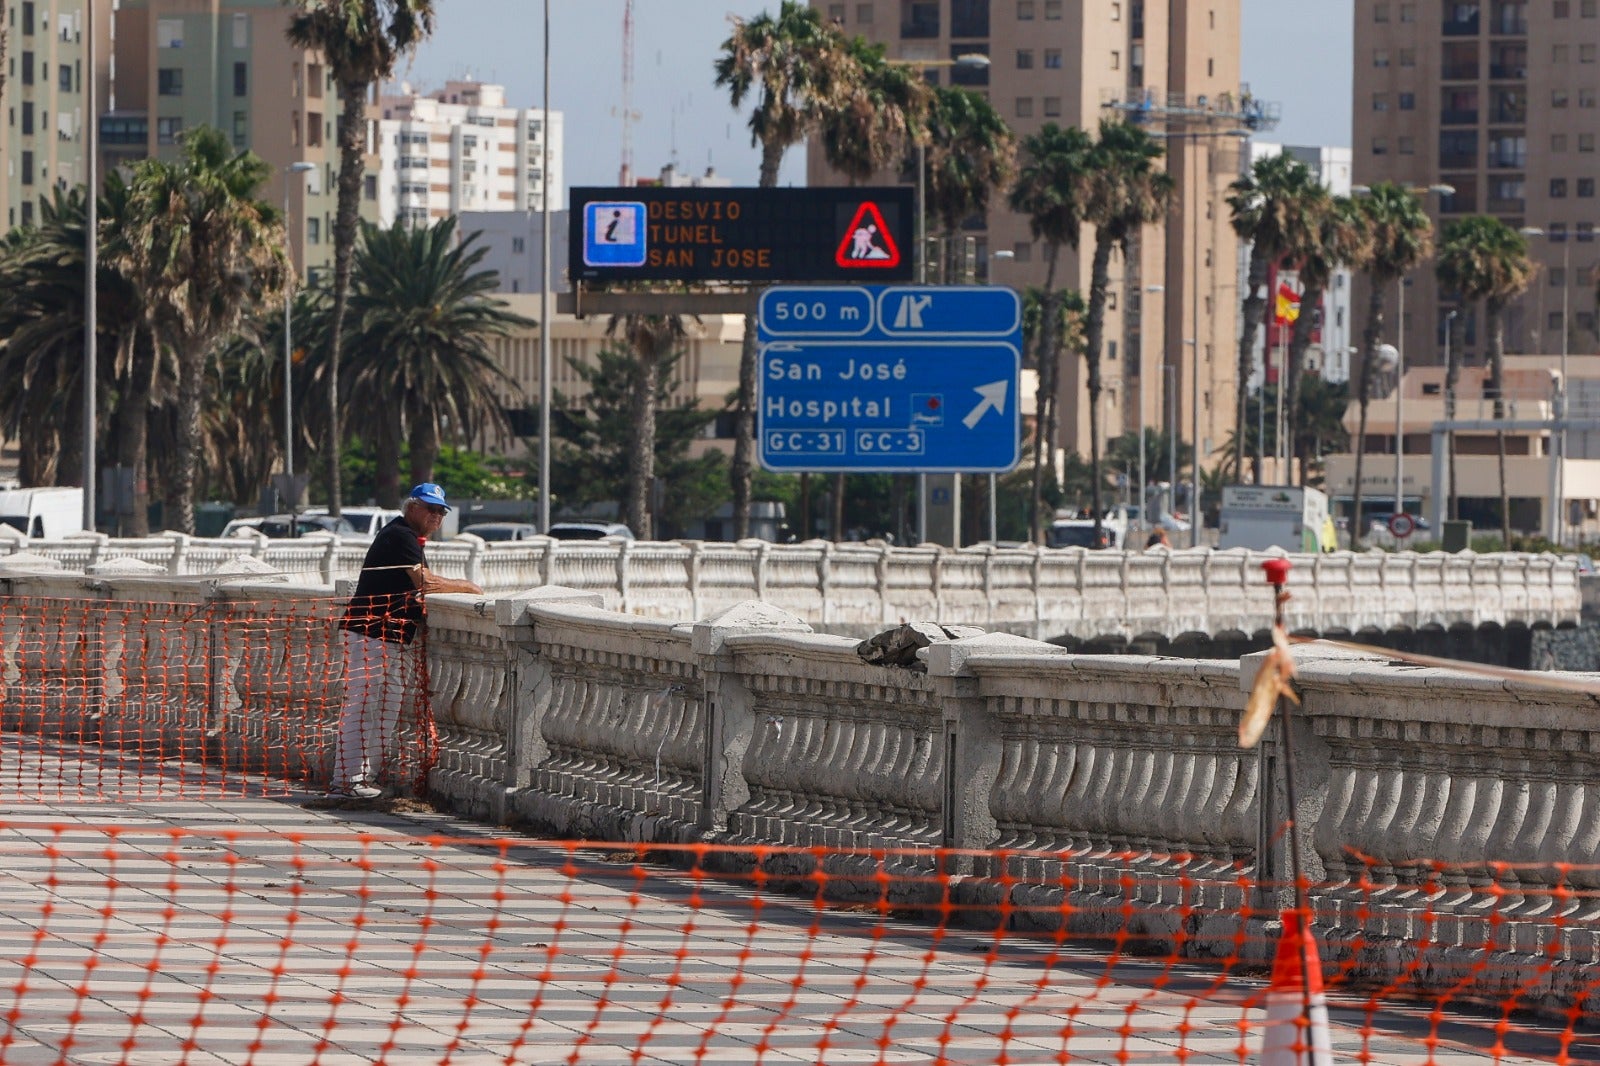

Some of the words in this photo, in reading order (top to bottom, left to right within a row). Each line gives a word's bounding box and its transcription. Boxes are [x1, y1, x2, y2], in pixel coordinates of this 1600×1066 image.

[649, 201, 741, 220] DESVIO
[649, 224, 723, 244] TUNEL
[649, 248, 695, 268] SAN
[711, 248, 771, 268] JOSE
[775, 302, 827, 320] 500
[839, 305, 860, 320] m
[768, 358, 822, 380] San
[838, 358, 907, 380] José
[766, 396, 891, 423] Hospital
[769, 433, 843, 451] GC-31
[858, 433, 921, 451] GC-3
